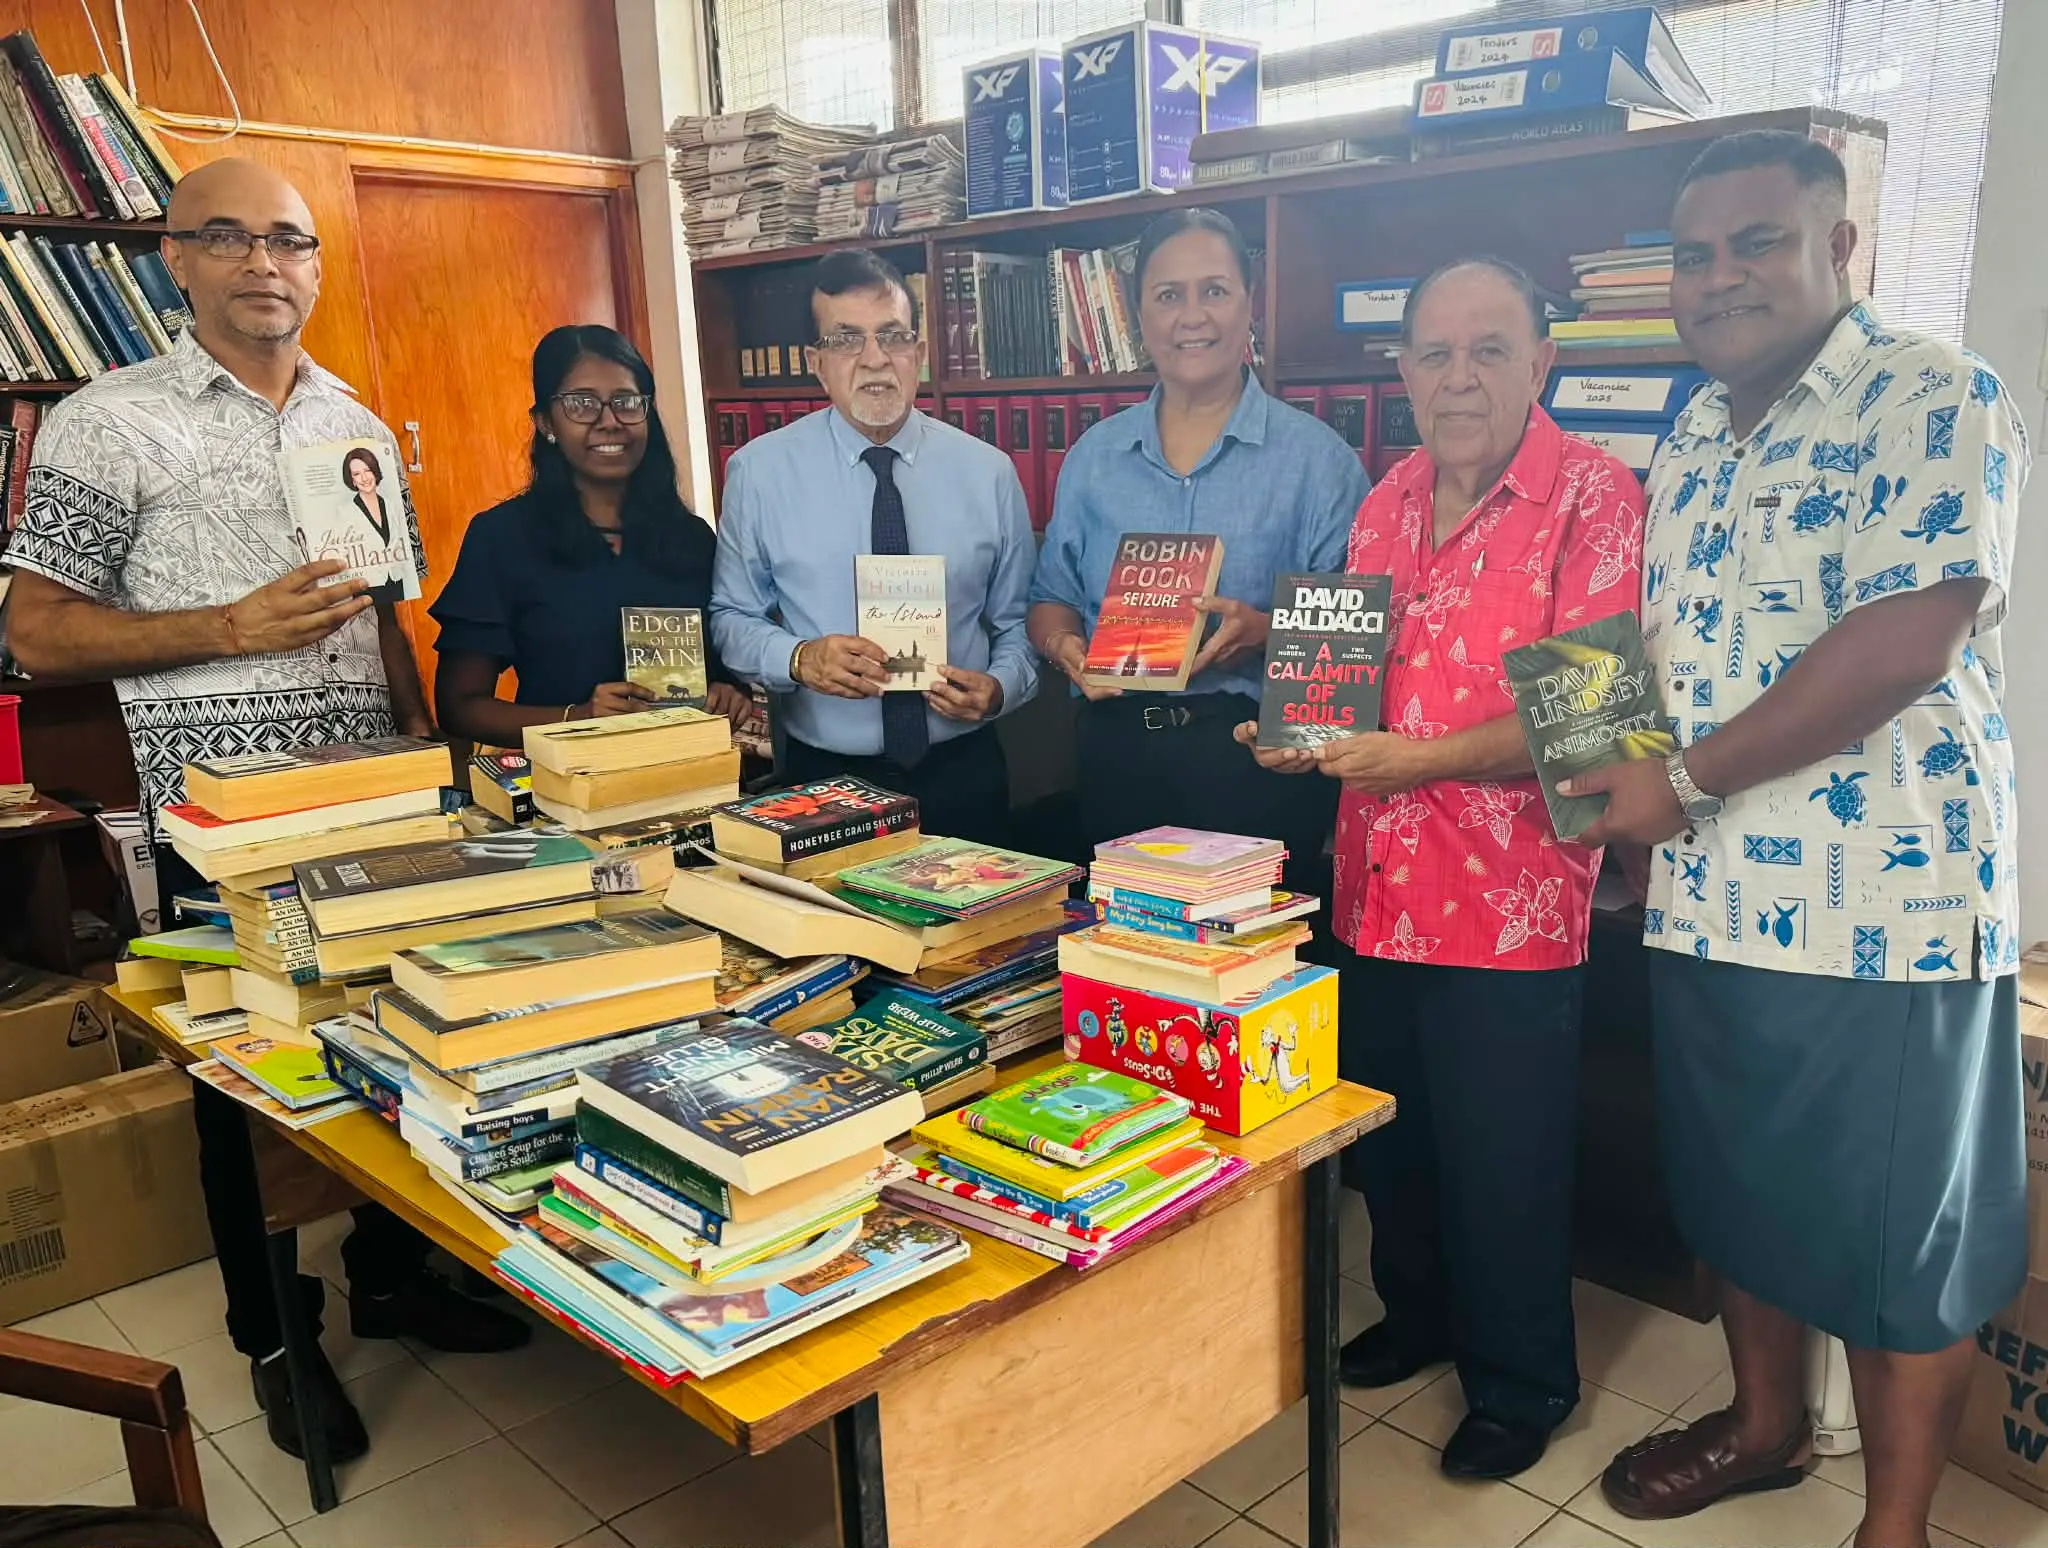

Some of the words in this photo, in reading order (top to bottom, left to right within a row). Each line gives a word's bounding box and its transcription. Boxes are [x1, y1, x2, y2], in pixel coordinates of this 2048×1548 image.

[1478, 37, 1519, 48] Tenders
[1480, 53, 1509, 63] 2024
[1457, 96, 1487, 106] 2024
[1512, 127, 1548, 140] WORLD
[1551, 121, 1583, 135] ATLAS
[1580, 378, 1631, 391] Vacancies
[315, 525, 365, 552] Julia
[1120, 540, 1207, 564] ROBIN
[1119, 564, 1193, 590] COOK
[1121, 591, 1181, 608] SEIZURE
[1294, 587, 1364, 611] DAVID
[629, 615, 697, 633] EDGE
[1271, 608, 1385, 634] BALDACCI
[650, 636, 668, 646] OF
[672, 636, 697, 646] THE
[1315, 641, 1333, 662] A
[631, 648, 698, 667] RAIN
[1267, 661, 1381, 685] CALAMITY
[1537, 654, 1625, 701] DAVID
[1306, 683, 1337, 703] OF
[1529, 670, 1647, 729] LINDSEY
[1282, 702, 1356, 727] SOULS
[1543, 710, 1656, 763] ANIMOSITY
[808, 784, 873, 809] CRAIG
[829, 779, 897, 807] SILVEY
[723, 804, 797, 831] HONEYBEE
[790, 829, 842, 853] HONEYBEE
[844, 821, 872, 837] CRAIG
[872, 813, 902, 830] SILVEY
[271, 898, 282, 907] AN
[274, 908, 286, 917] AN
[282, 919, 293, 927] AN
[286, 929, 297, 937] AN
[286, 961, 297, 970] AN
[887, 1002, 919, 1023] WEBB
[641, 1036, 728, 1067] BLUE
[834, 1018, 937, 1064] DAYS
[642, 1039, 793, 1095] MIDNIGHT
[666, 1044, 730, 1074] AND
[944, 1055, 964, 1072] WEBB
[700, 1066, 867, 1133] RANKIN
[1199, 1102, 1222, 1118] THE
[476, 1117, 510, 1133] Raising
[513, 1113, 535, 1126] boys
[766, 1094, 851, 1130] IAN
[468, 1145, 508, 1167] Chicken
[507, 1140, 532, 1158] Soup
[532, 1137, 549, 1150] for
[549, 1132, 564, 1145] the
[470, 1157, 509, 1179] Father's
